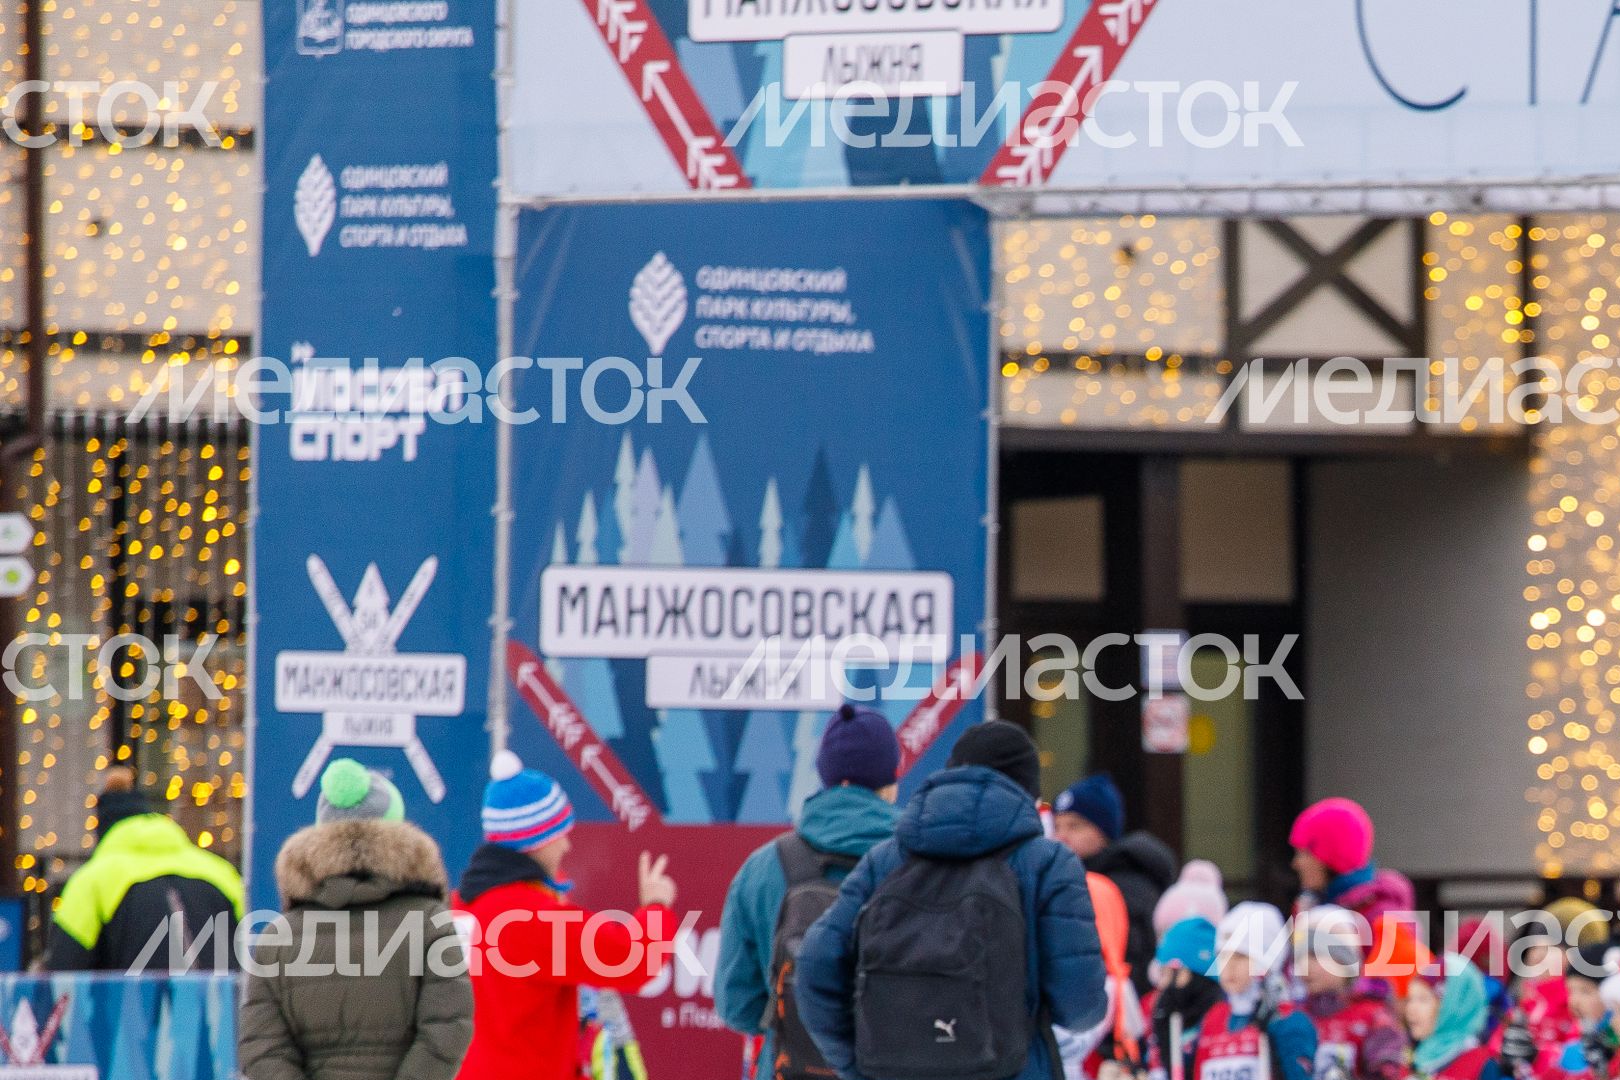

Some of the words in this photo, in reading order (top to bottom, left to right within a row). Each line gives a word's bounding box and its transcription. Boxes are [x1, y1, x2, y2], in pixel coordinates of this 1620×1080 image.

[821, 43, 924, 85] ЛЫЖНЯ
[290, 415, 426, 461] СПОРТ
[556, 584, 936, 640] МАНЖОСОВСКАЯ
[284, 664, 457, 700] МАНЖОСОВСКАЯ
